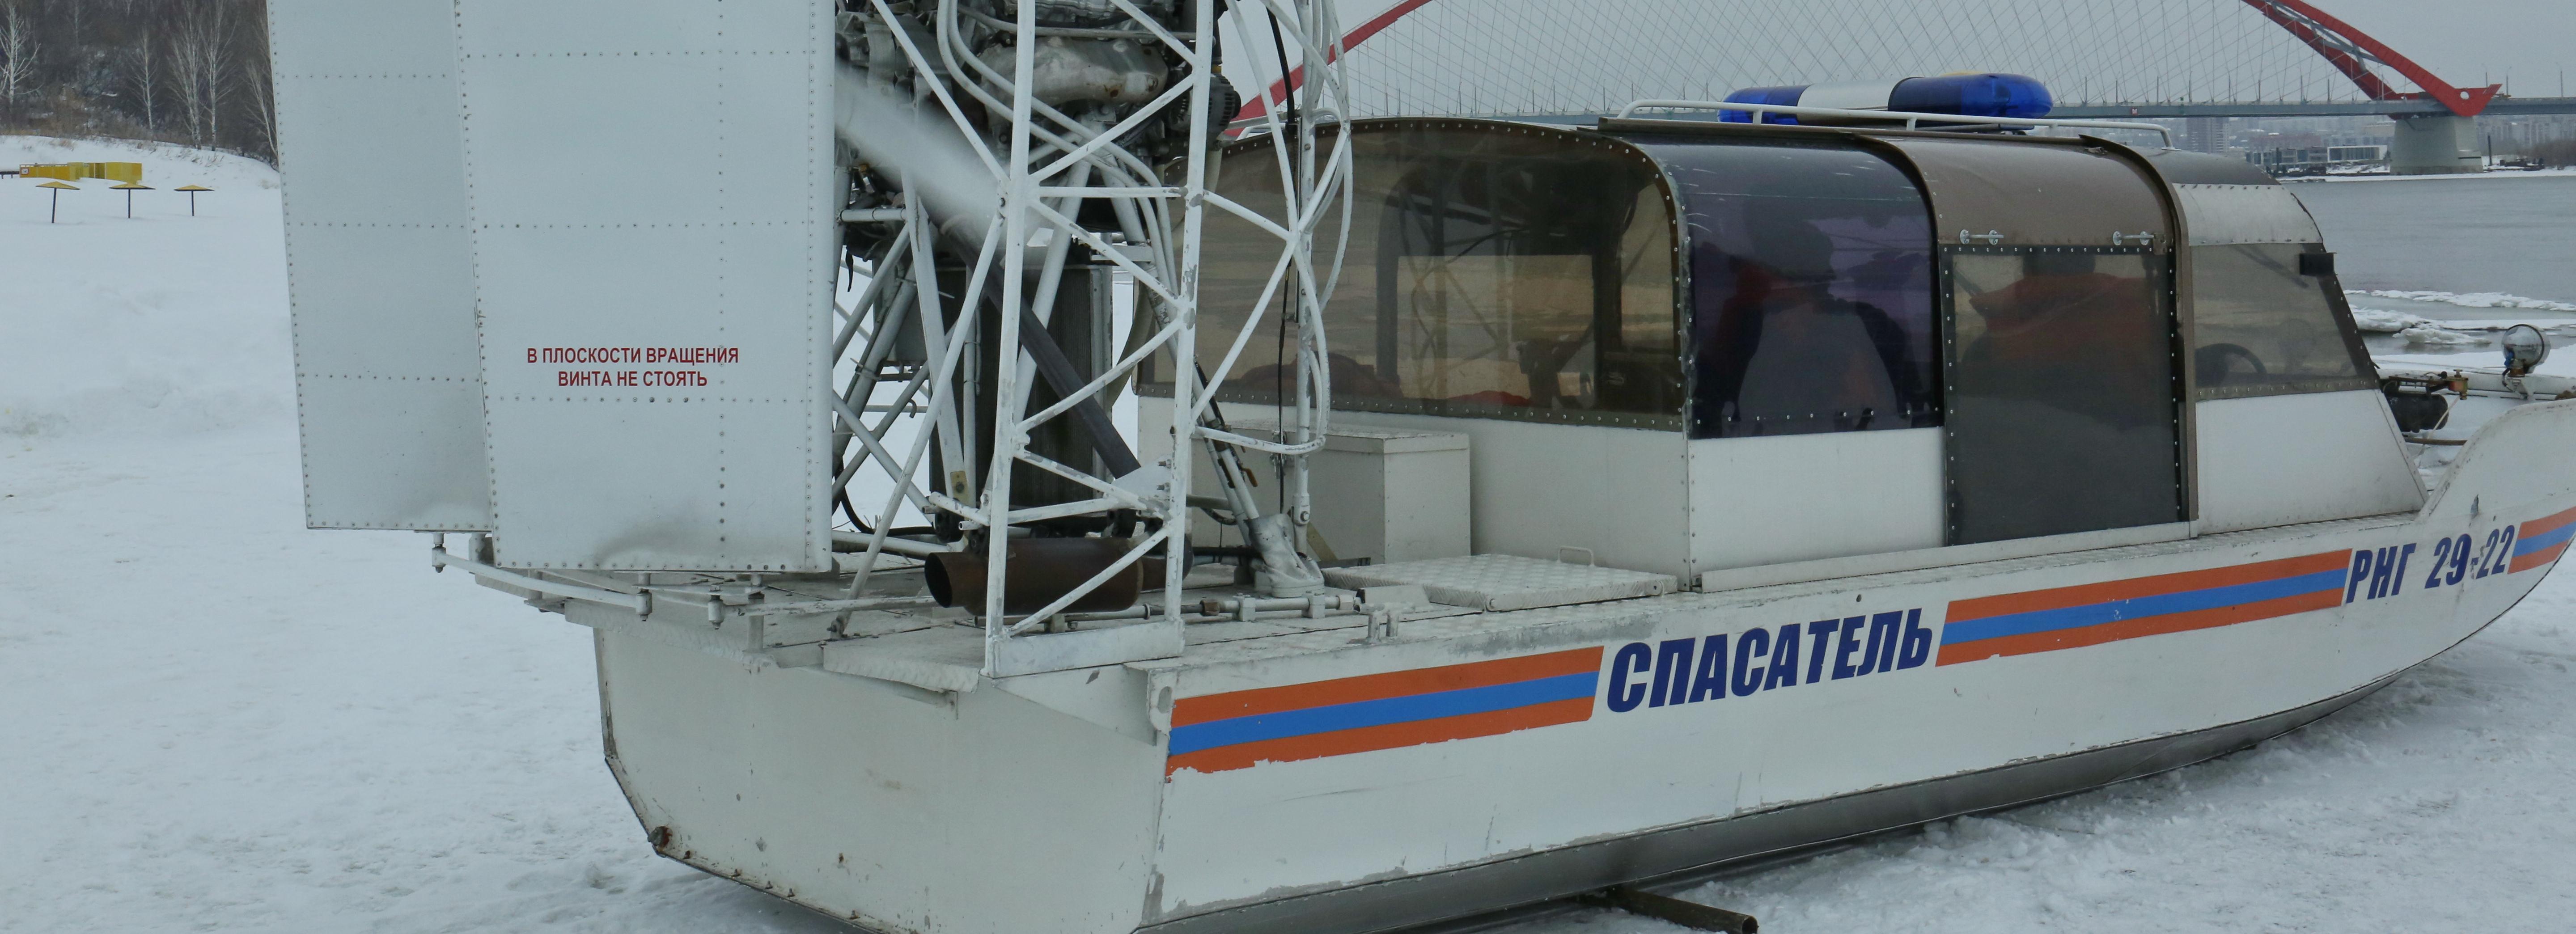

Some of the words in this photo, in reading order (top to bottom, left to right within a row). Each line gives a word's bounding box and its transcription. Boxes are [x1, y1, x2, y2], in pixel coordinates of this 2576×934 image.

[528, 348, 537, 363] В
[543, 347, 641, 363] ПЛОСКОСТИ
[646, 347, 738, 366] ВРАЩЕНИЯ
[558, 371, 611, 386] ВИНТА
[617, 371, 637, 386] НЕ
[643, 371, 708, 387] СТОЯТЬ
[2345, 542, 2417, 604] РНГ
[2424, 524, 2515, 589] 29-22
[1607, 608, 1932, 713] СПАСАТЕЛЬ
